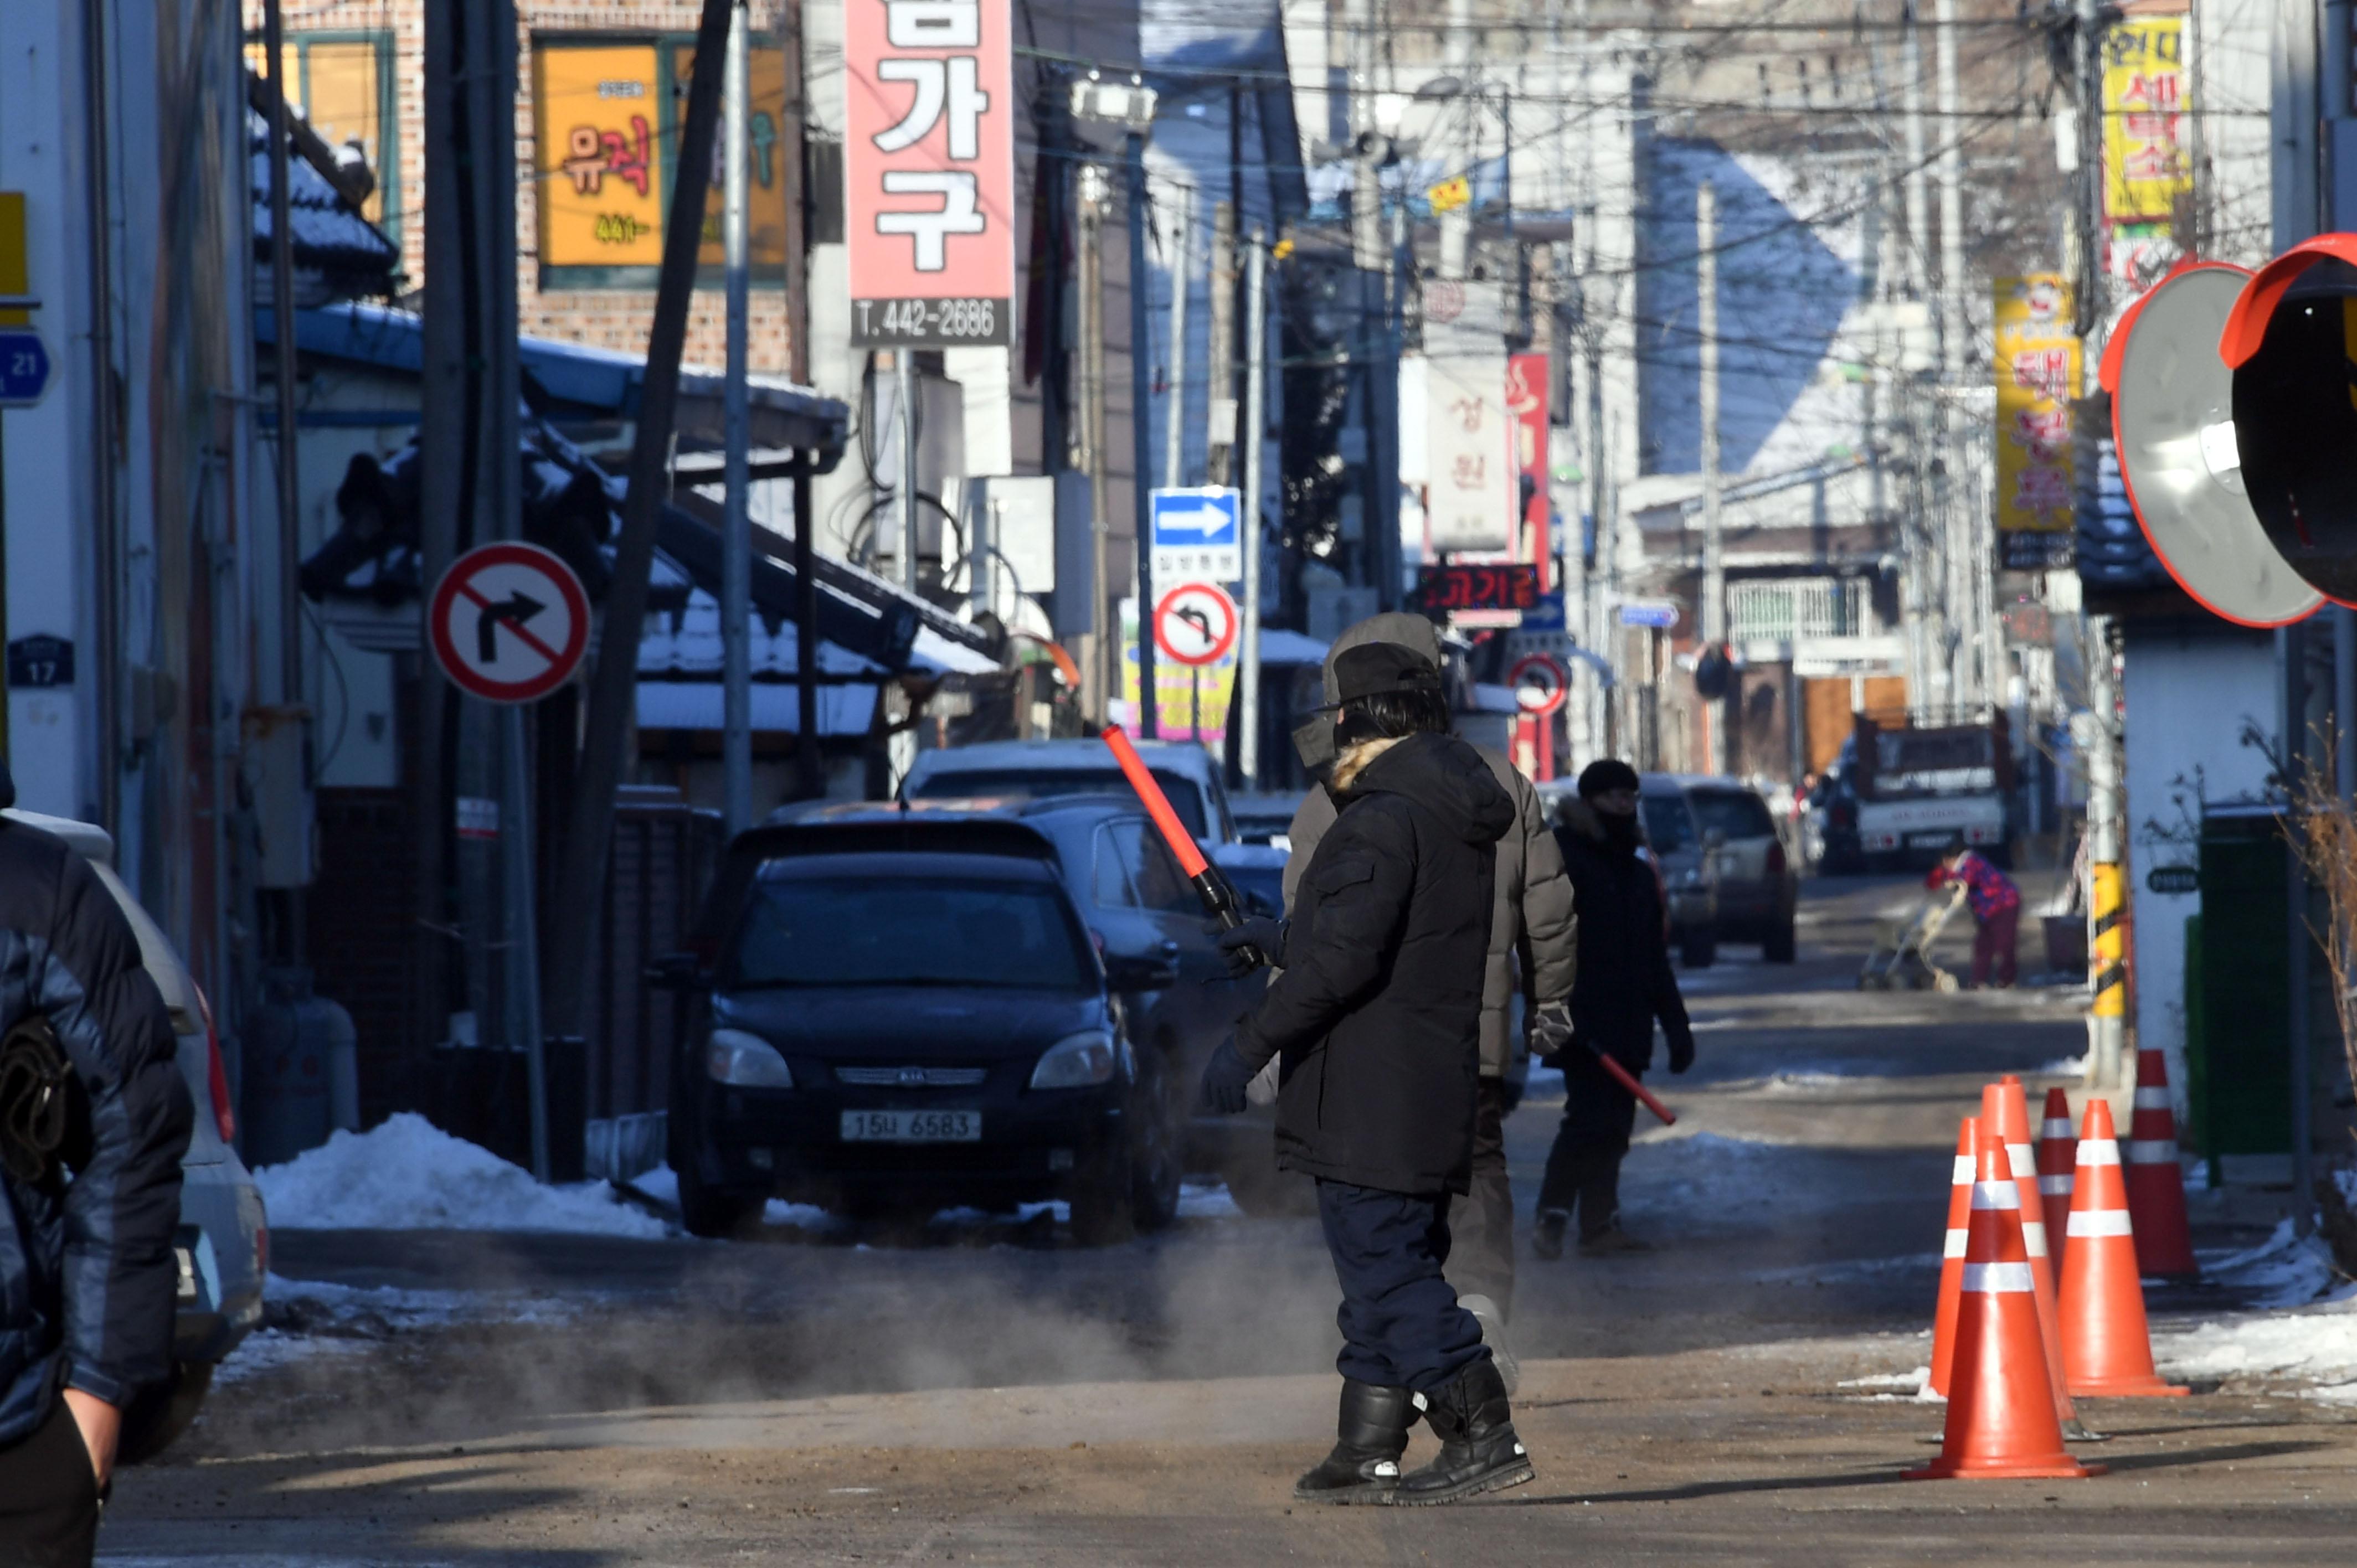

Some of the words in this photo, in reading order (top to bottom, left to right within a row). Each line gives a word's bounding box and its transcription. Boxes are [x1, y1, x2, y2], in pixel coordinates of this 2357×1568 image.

[12, 352, 36, 375] 21
[29, 662, 56, 682] 17
[910, 1111, 969, 1135] 6583
